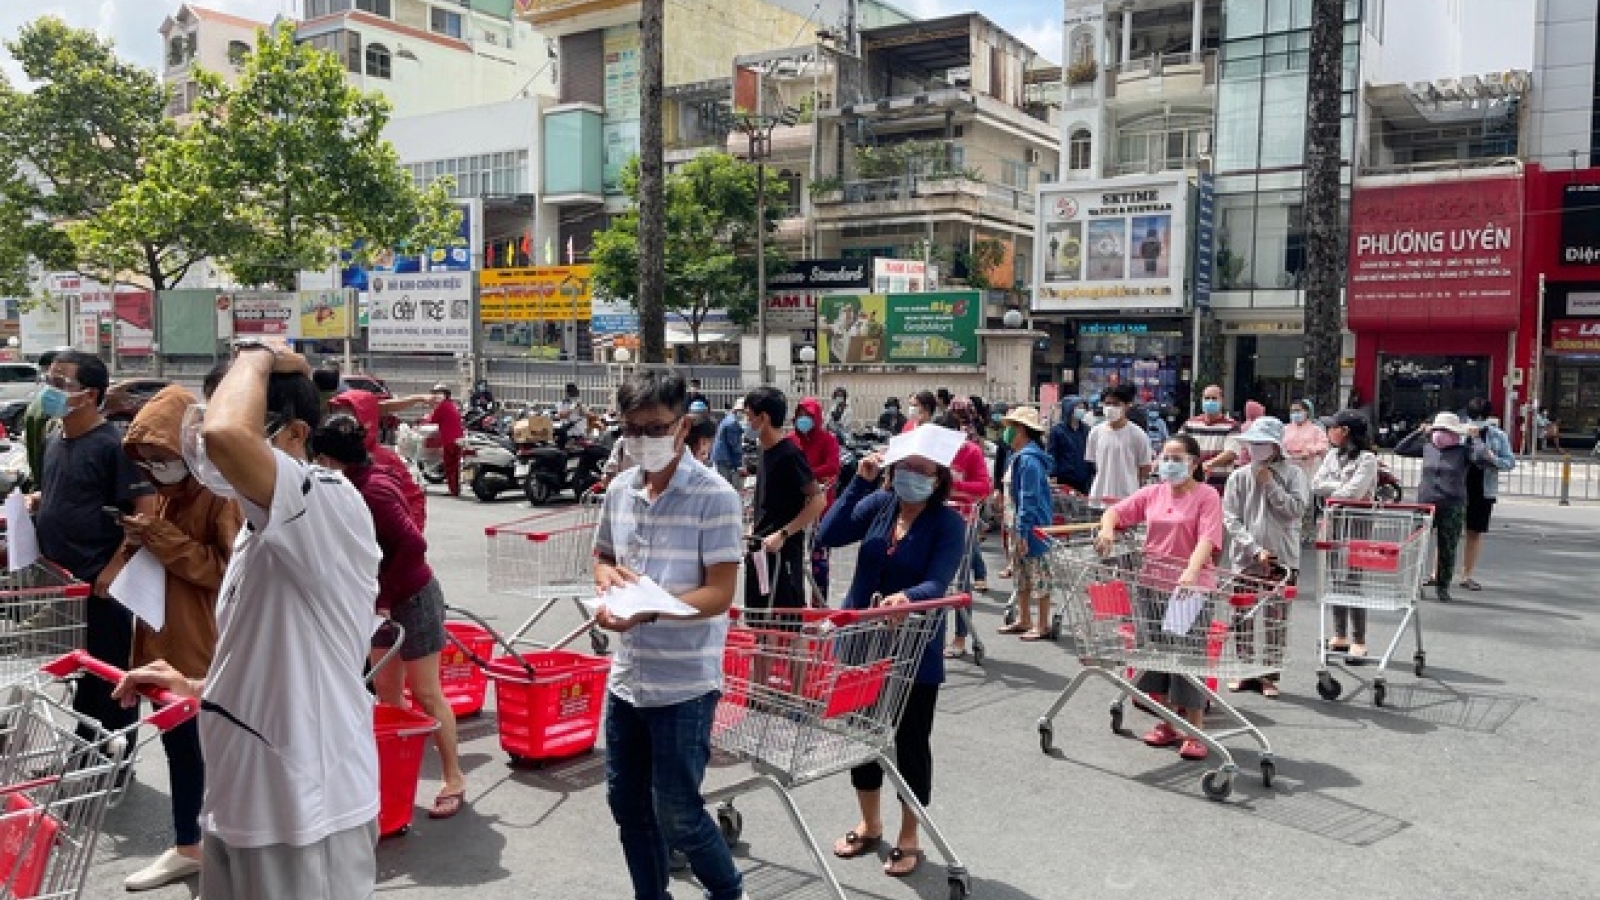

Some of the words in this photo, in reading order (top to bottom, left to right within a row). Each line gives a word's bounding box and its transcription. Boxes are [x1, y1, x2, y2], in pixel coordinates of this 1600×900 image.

[1357, 228, 1445, 256] PHƯƠNG
[1450, 222, 1511, 251] UYÊN
[810, 265, 864, 282] Standard
